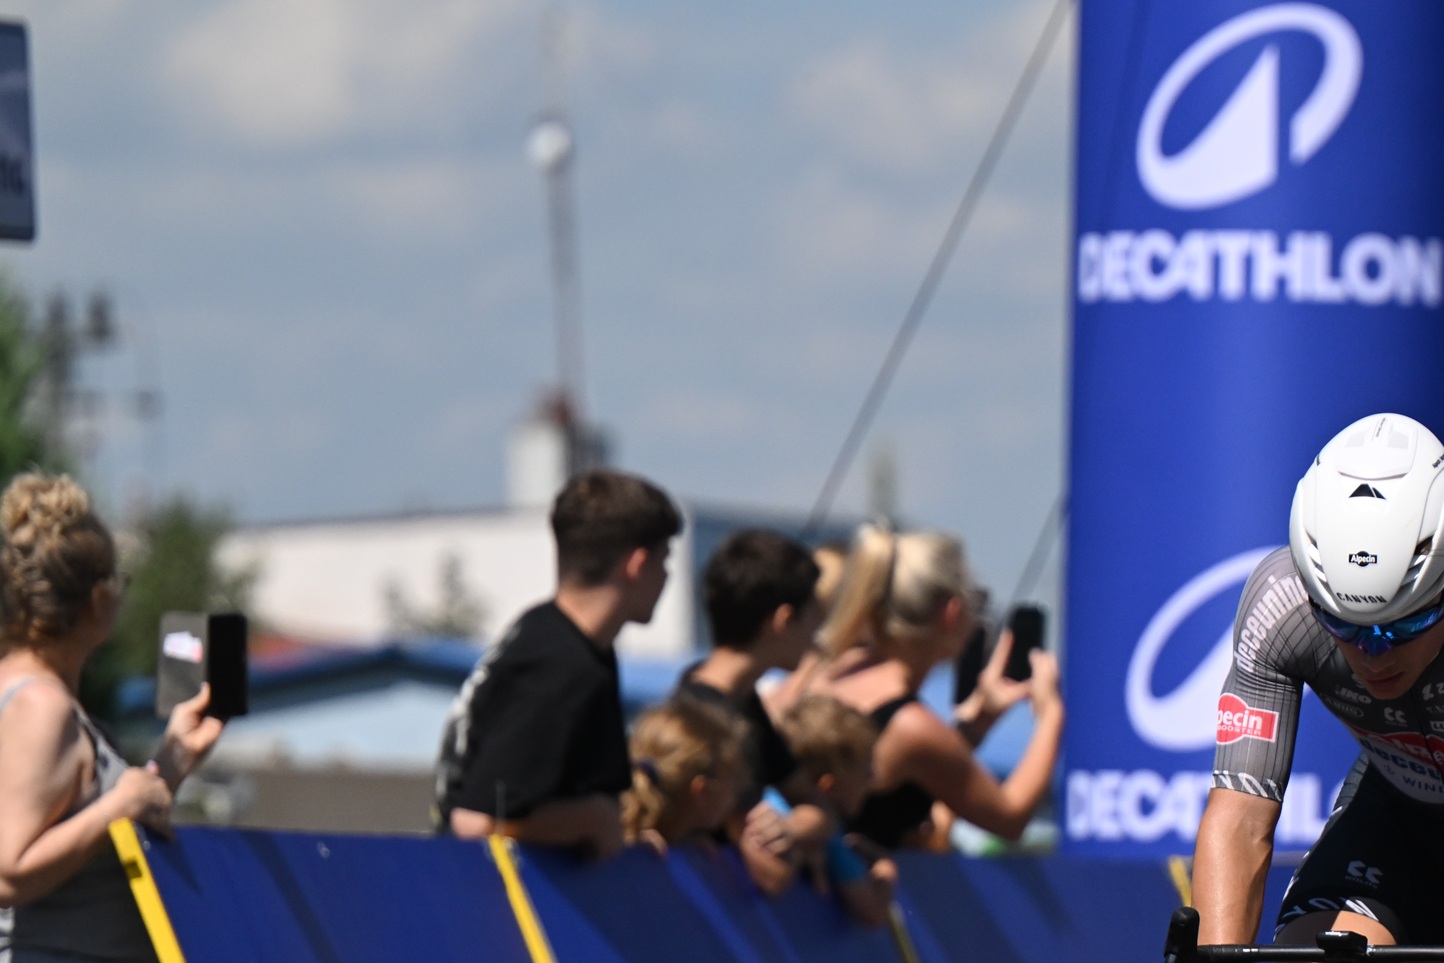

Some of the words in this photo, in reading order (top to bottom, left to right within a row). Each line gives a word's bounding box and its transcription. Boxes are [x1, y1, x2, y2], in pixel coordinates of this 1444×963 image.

[1079, 228, 1444, 308] DECATHLON
[1351, 554, 1376, 566] Alpecin
[1336, 592, 1387, 604] CANYON
